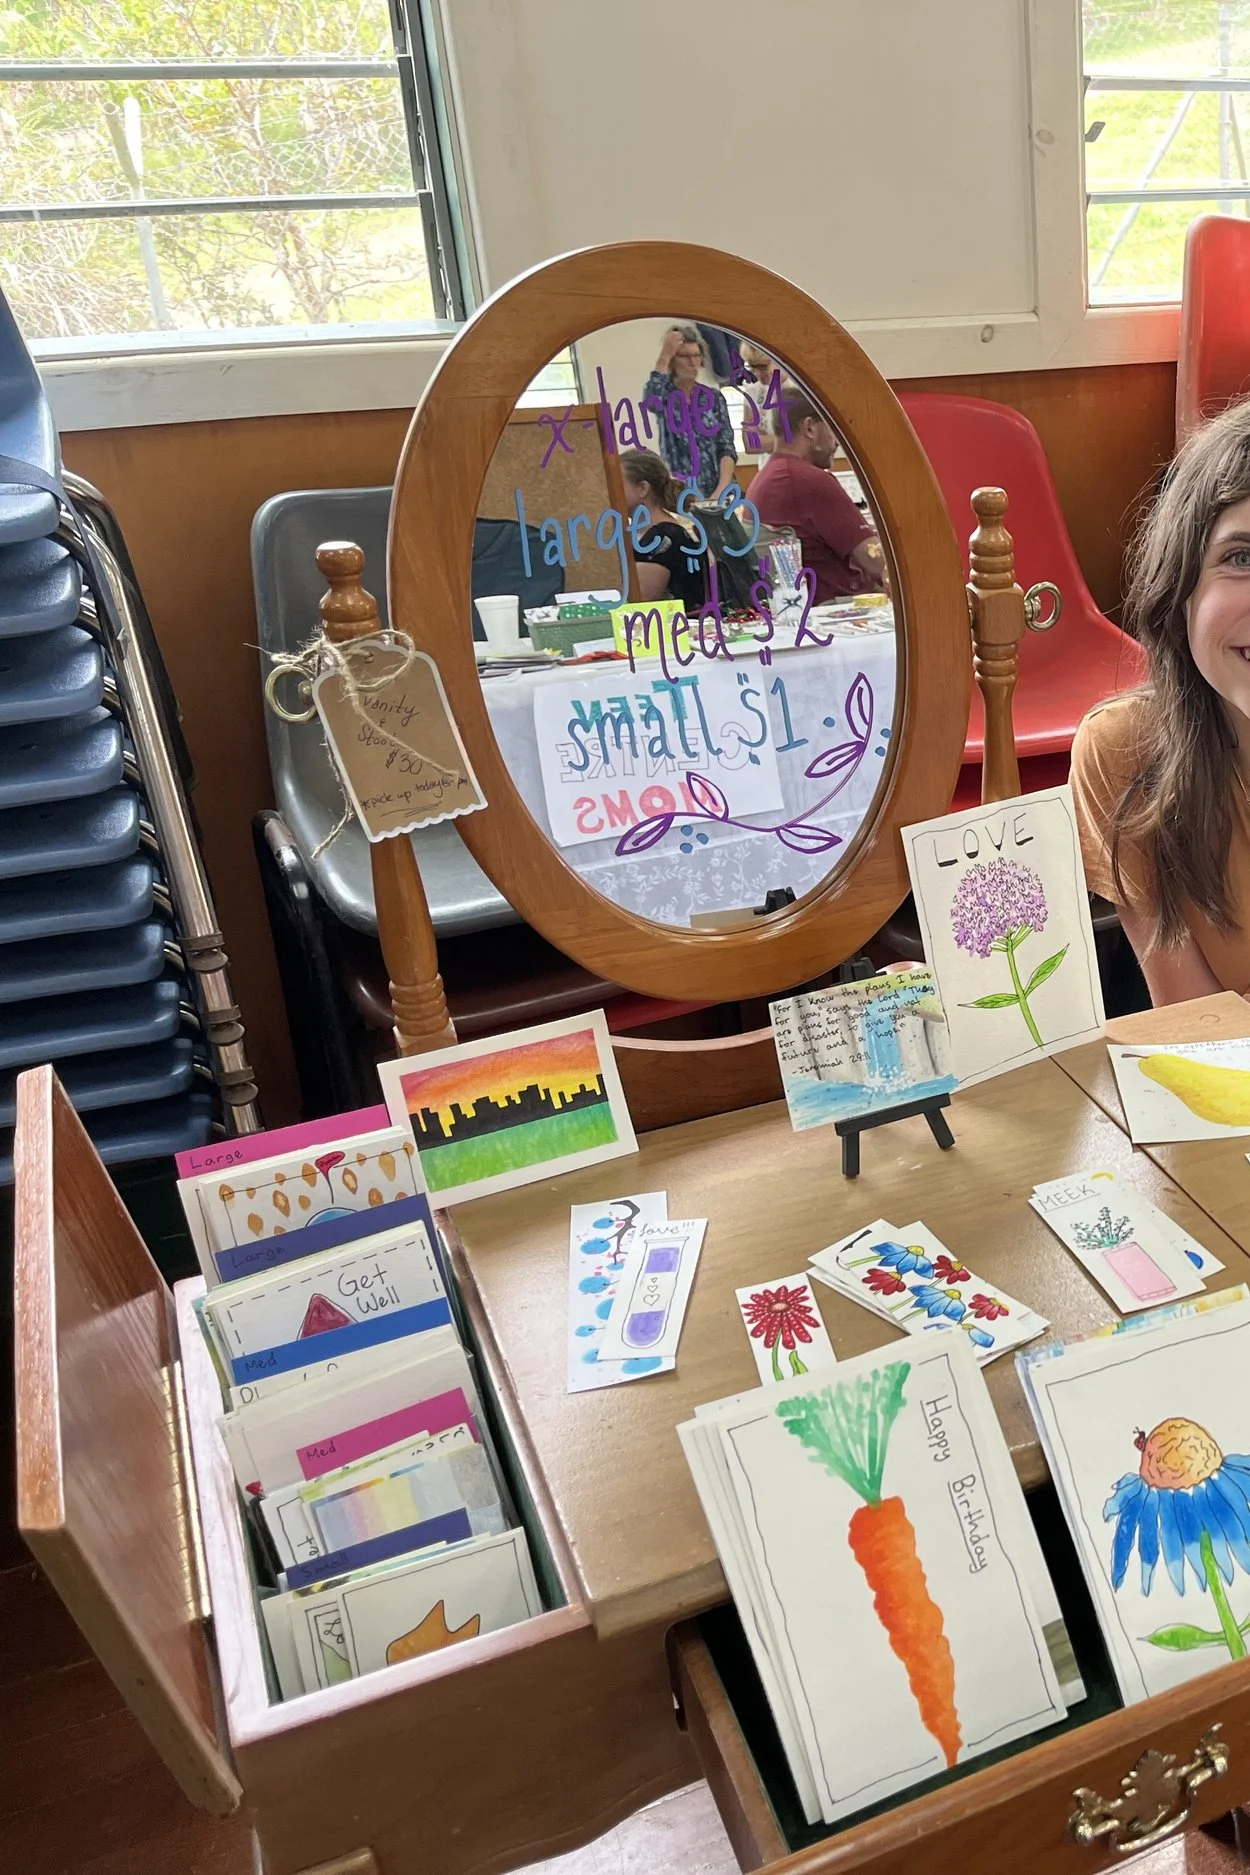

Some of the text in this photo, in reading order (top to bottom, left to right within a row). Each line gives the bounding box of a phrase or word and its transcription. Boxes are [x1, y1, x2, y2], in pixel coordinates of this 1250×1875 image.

[537, 366, 721, 481] x-large
[514, 476, 760, 608] large $3
[624, 555, 834, 684] med $2
[364, 694, 420, 727] Vanity
[568, 672, 809, 771] small $1
[385, 748, 423, 775] $30
[397, 790, 411, 803] up
[932, 812, 1035, 867] LOVE
[795, 999, 803, 1009] I
[841, 988, 859, 997] the
[865, 982, 891, 995] plans
[895, 974, 906, 984] I
[910, 972, 932, 980] have
[775, 1016, 789, 1026] for
[827, 1004, 852, 1016] says
[857, 997, 874, 1007] the
[776, 999, 921, 1038] are plans for good and not
[778, 1040, 795, 1049] for
[848, 1024, 859, 1032] to
[865, 1019, 885, 1033] give
[889, 1013, 906, 1025] you
[781, 1047, 819, 1062] future
[826, 1038, 849, 1051] and
[848, 1052, 871, 1064] 29:11
[189, 1148, 243, 1169] Large
[1037, 1184, 1096, 1211] MEEK
[231, 1246, 286, 1268] Large
[337, 1263, 388, 1297] Get
[355, 1284, 401, 1314] Well
[245, 1351, 278, 1372] Med
[306, 1443, 337, 1460] Med
[926, 1394, 990, 1574] Happy Birthday
[301, 1552, 349, 1578] Small
